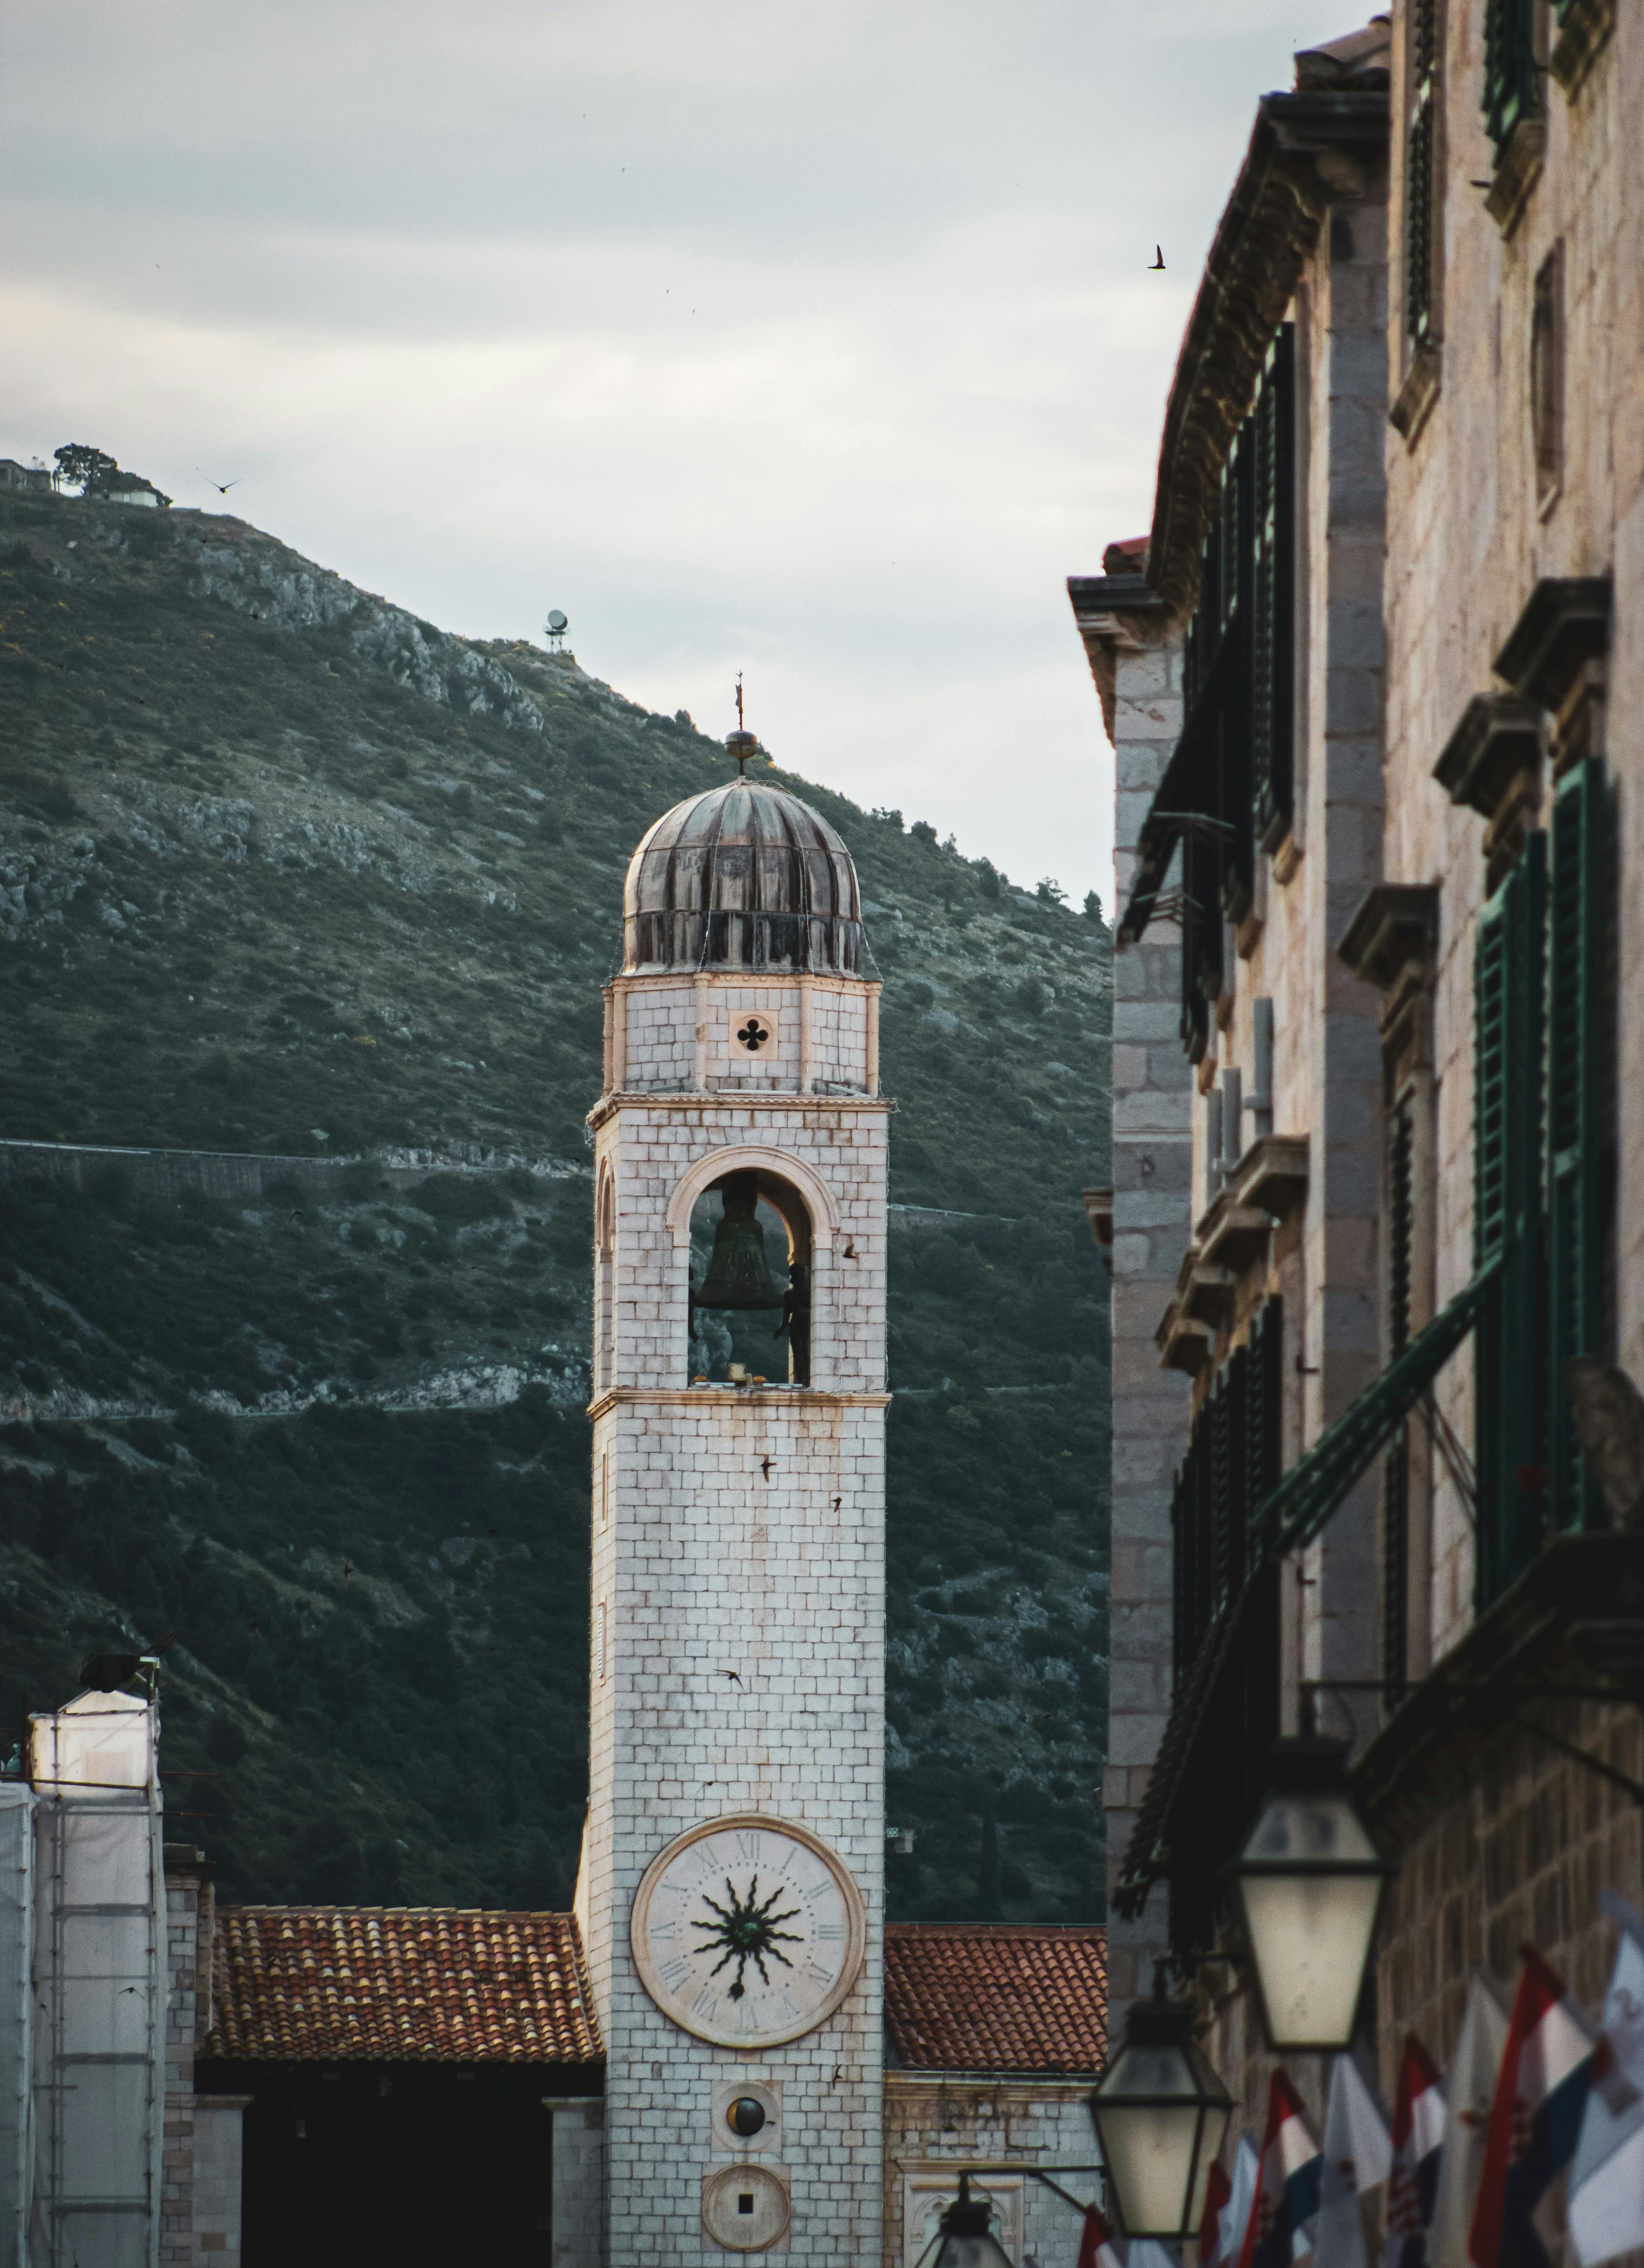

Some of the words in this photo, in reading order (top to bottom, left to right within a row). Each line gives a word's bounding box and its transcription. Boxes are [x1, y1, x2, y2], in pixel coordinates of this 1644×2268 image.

[736, 1833, 760, 1859] XII
[782, 1846, 797, 1871] I
[807, 1879, 833, 1900] II
[818, 1925, 844, 1940] III
[658, 1956, 691, 1994] VIII
[807, 1962, 834, 1991] IV
[691, 1990, 718, 2022] VII
